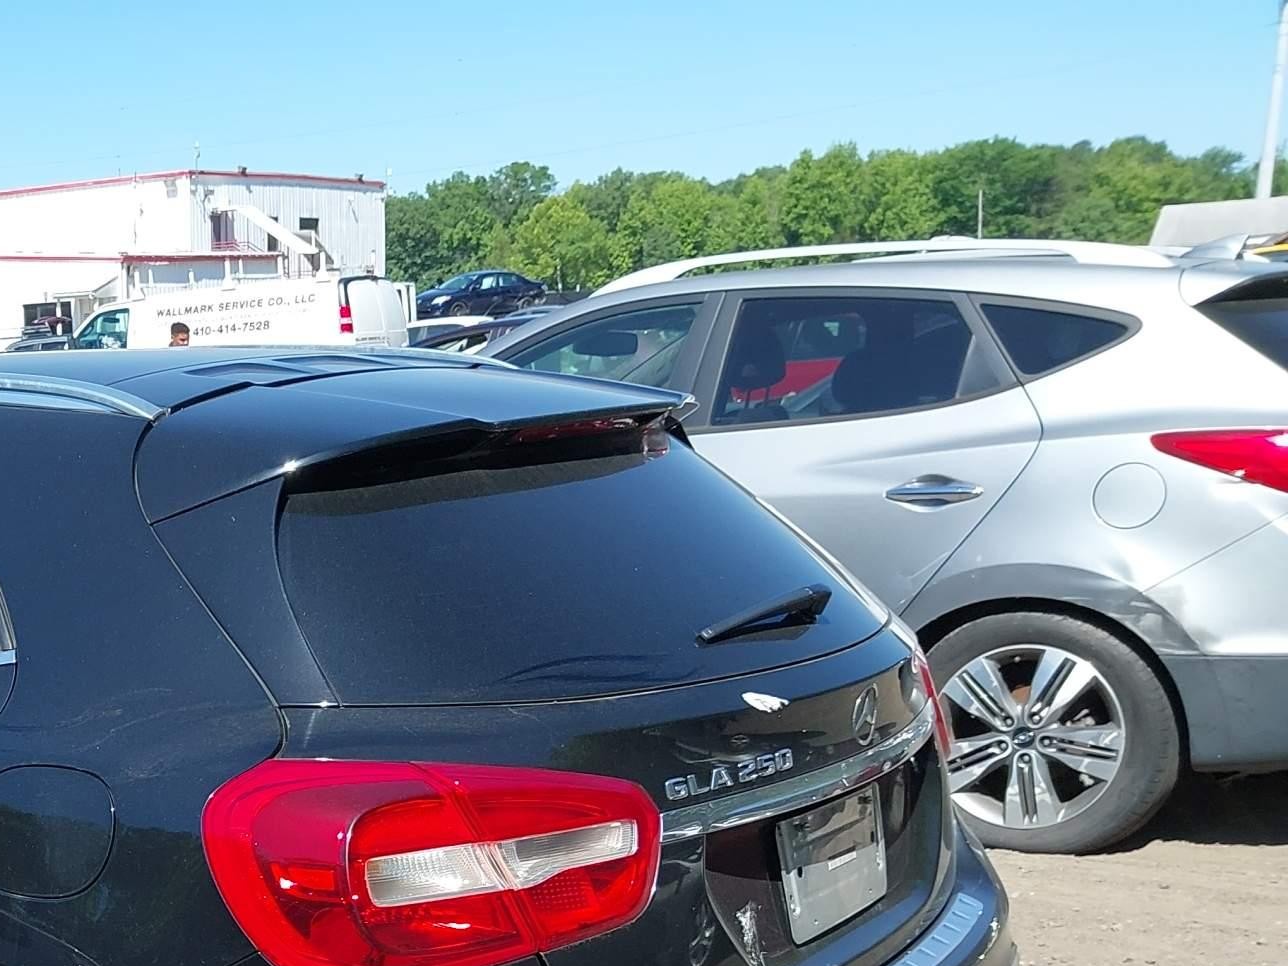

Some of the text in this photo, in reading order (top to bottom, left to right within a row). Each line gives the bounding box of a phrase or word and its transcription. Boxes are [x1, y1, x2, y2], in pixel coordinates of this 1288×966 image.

[156, 304, 214, 318] WALLMARK
[218, 298, 263, 312] SERVICE
[267, 296, 291, 307] CO.,
[294, 293, 316, 304] LLC
[192, 320, 270, 336] 410-414-7528
[664, 748, 794, 801] GLA 250
